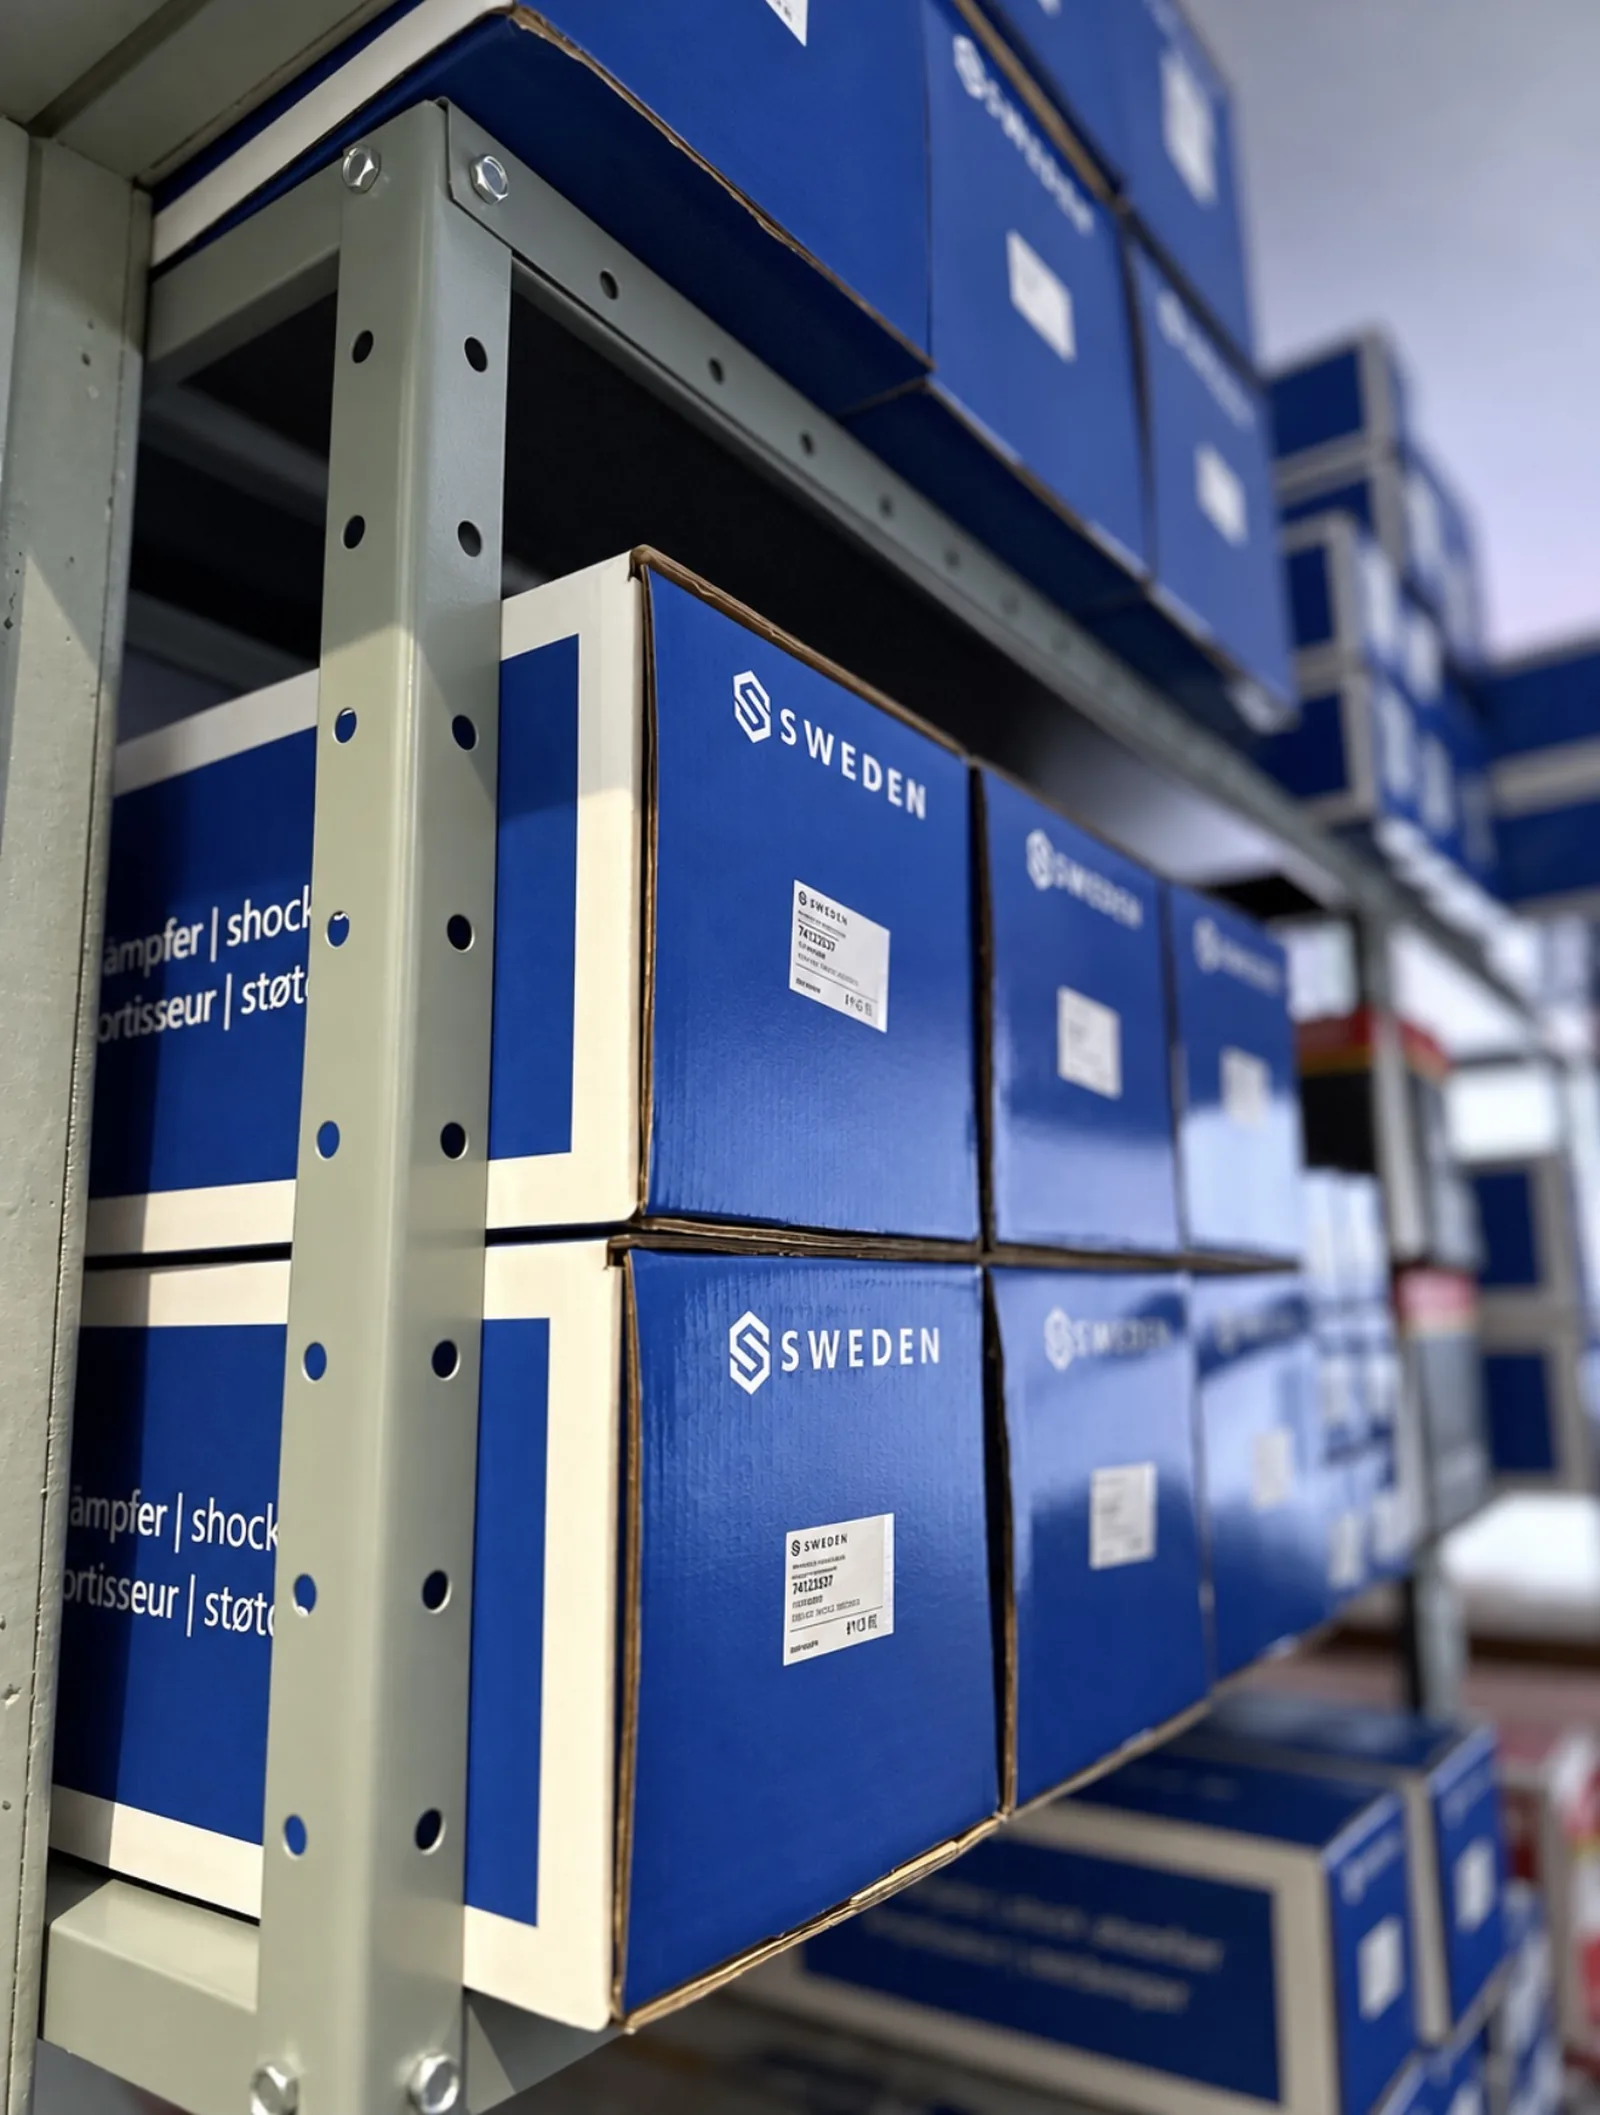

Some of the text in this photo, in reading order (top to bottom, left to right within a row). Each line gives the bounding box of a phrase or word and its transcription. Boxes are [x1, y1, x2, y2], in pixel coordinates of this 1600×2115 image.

[779, 708, 927, 821] SWEDEN
[781, 1327, 941, 1373] SWEDEN
[191, 1497, 278, 1552] shock
[804, 1534, 847, 1552] SWEDEN
